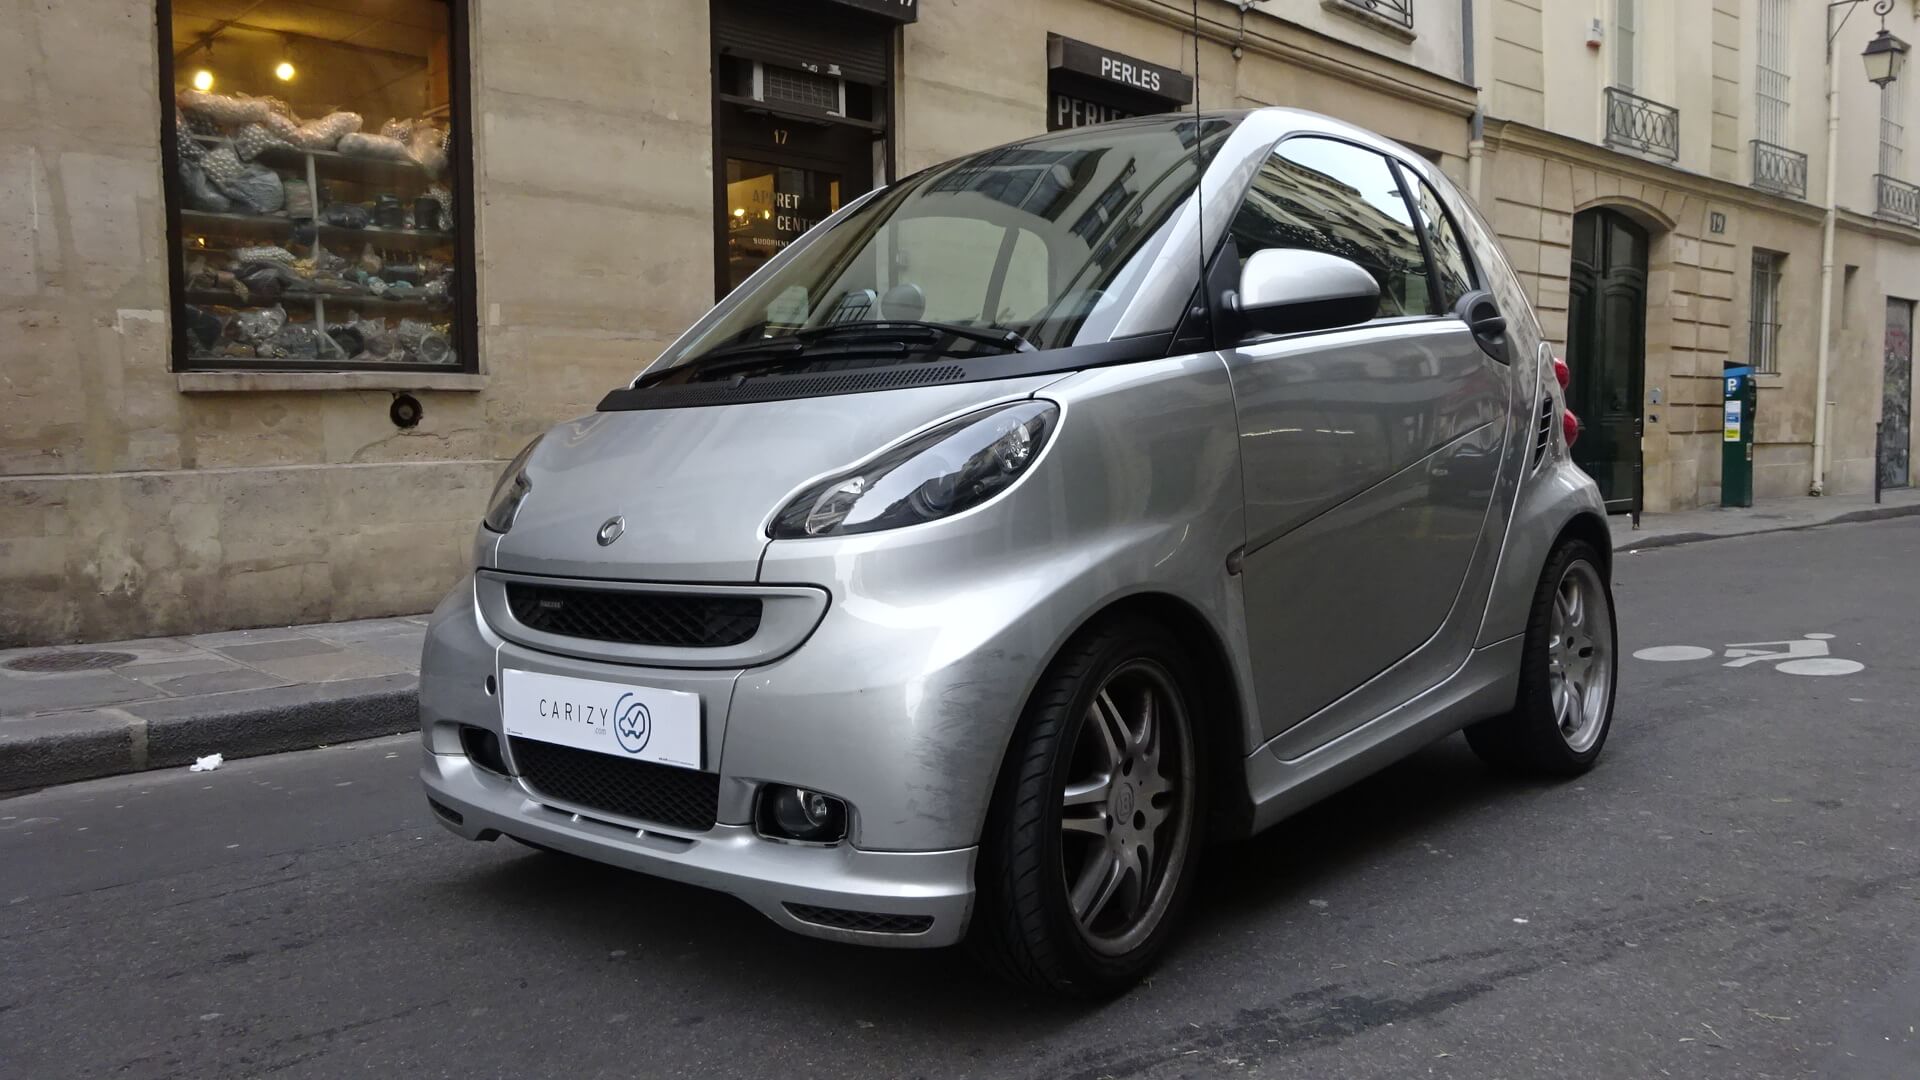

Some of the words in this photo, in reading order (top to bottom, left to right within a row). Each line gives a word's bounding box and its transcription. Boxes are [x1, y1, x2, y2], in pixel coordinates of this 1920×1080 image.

[1101, 56, 1160, 91] PERLES
[1057, 95, 1135, 129] PERL
[774, 129, 788, 145] 17
[539, 699, 608, 726] CARIZY
